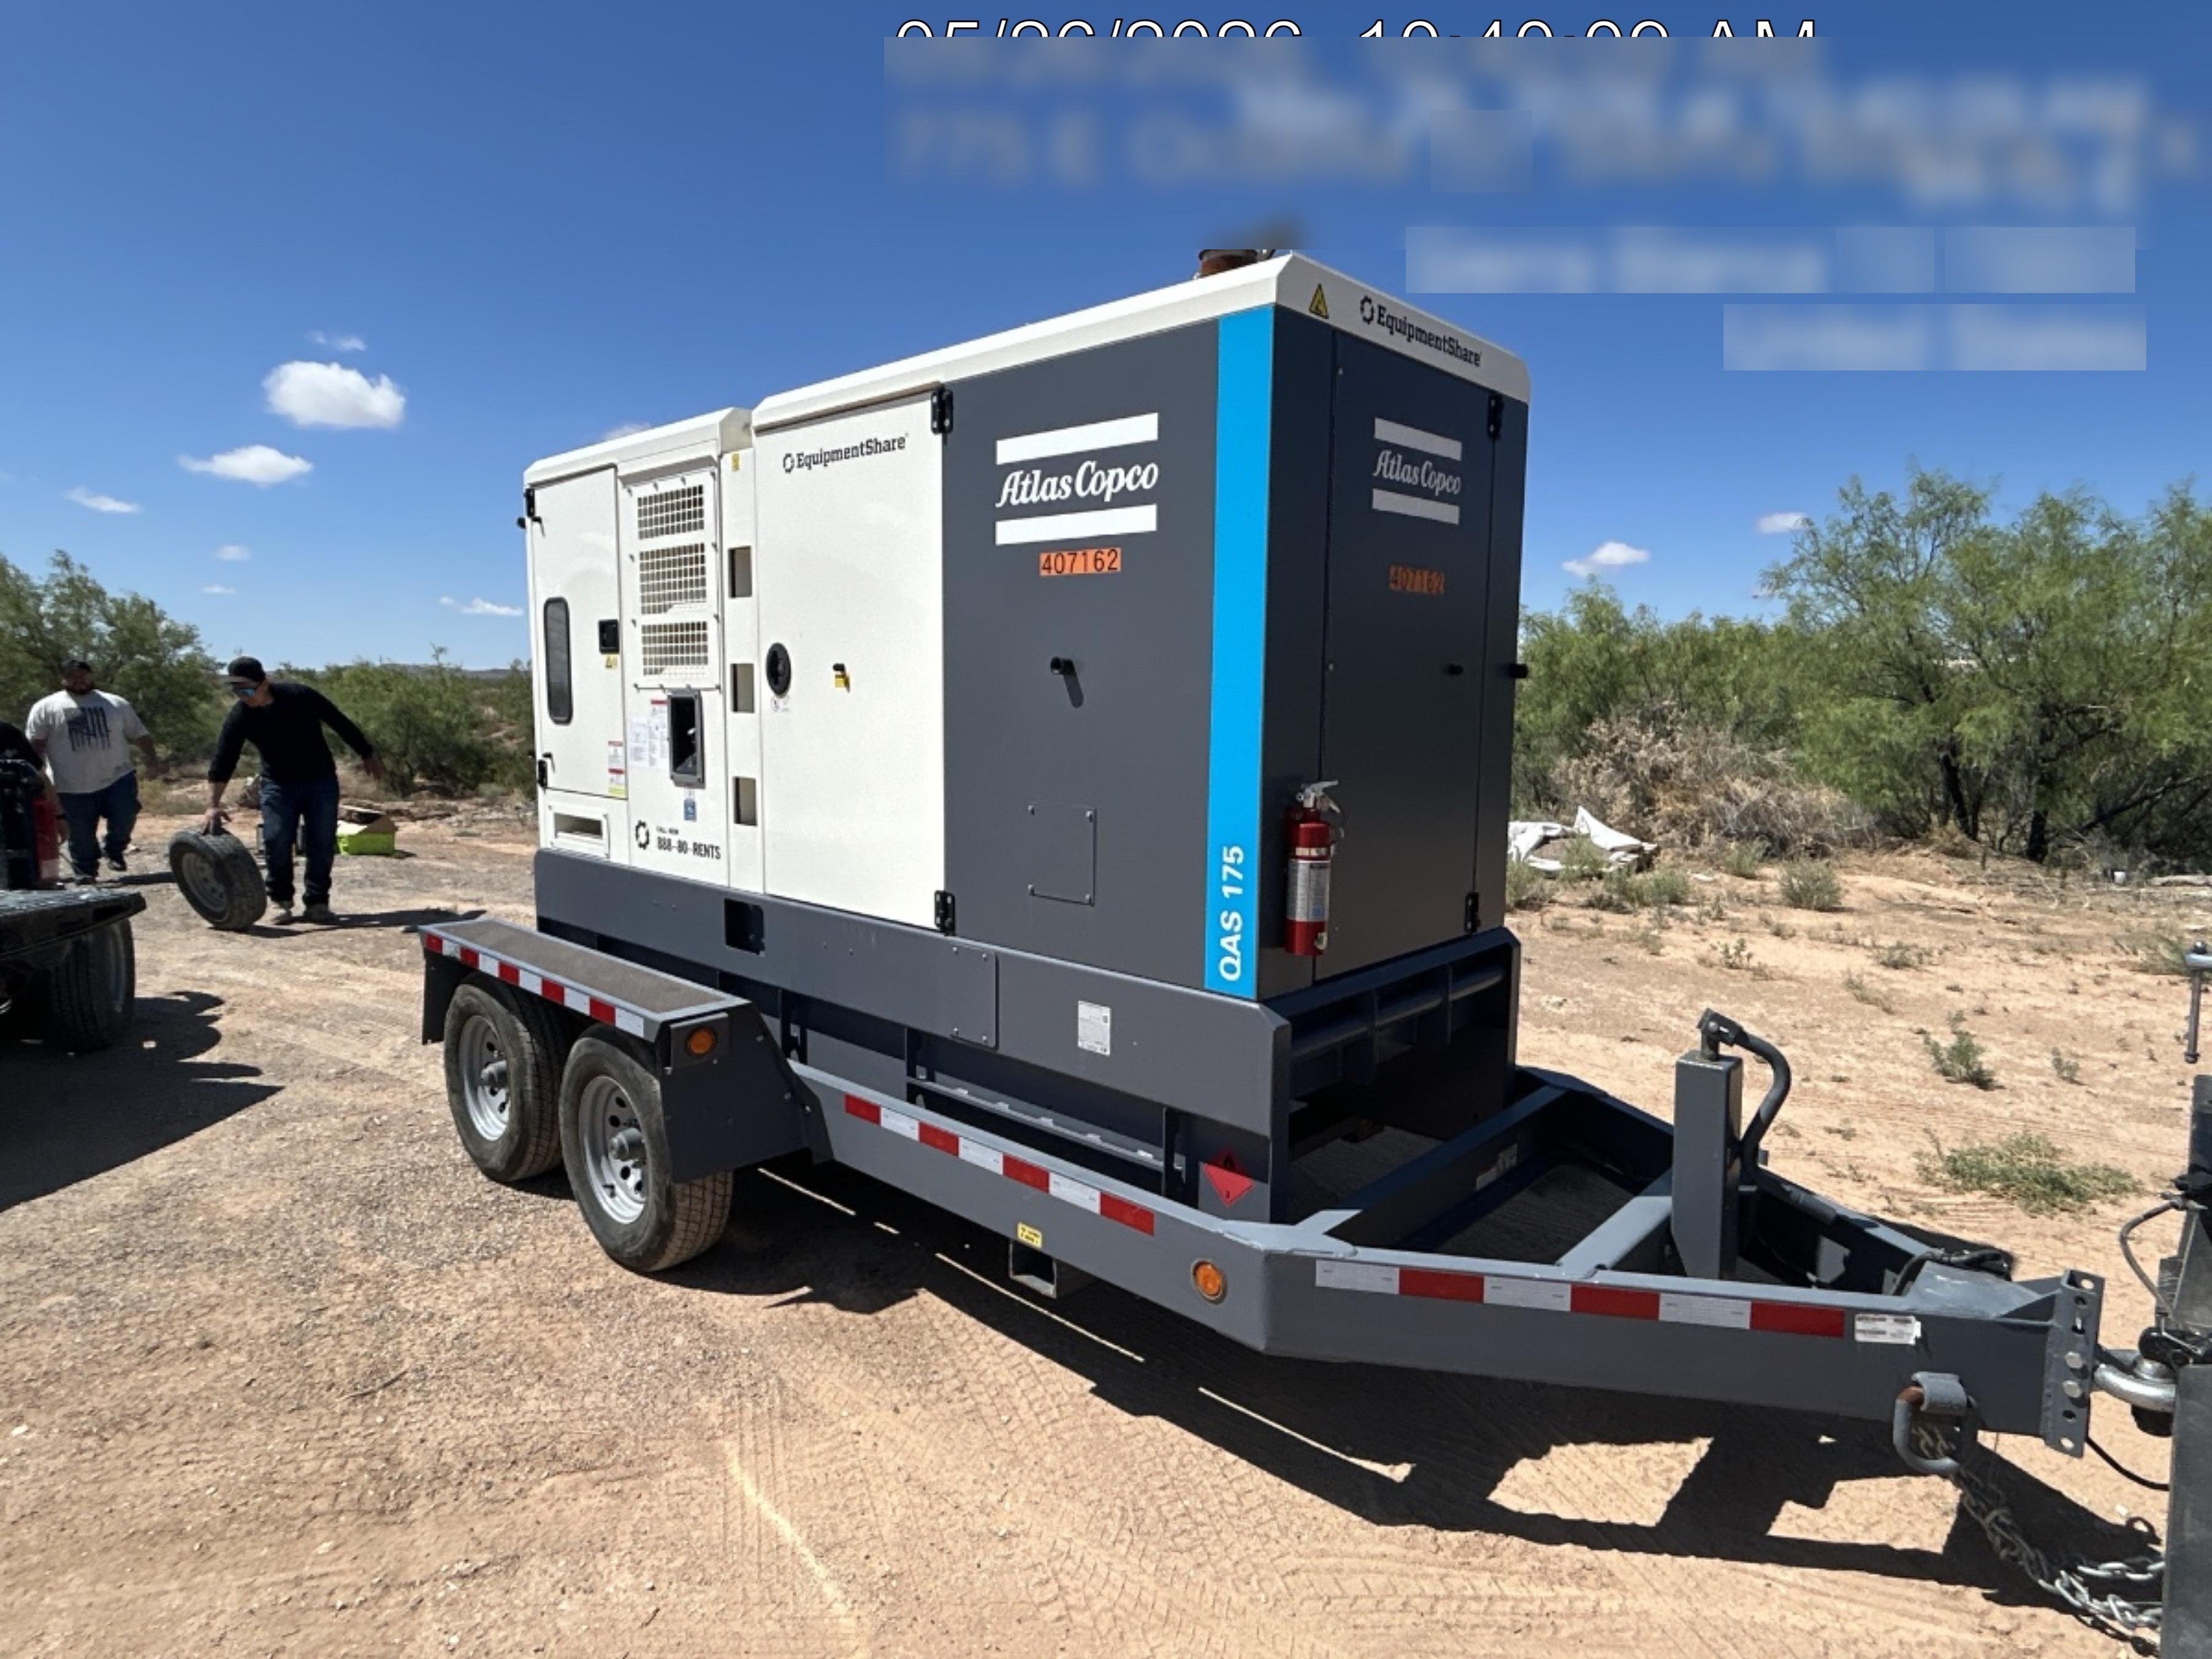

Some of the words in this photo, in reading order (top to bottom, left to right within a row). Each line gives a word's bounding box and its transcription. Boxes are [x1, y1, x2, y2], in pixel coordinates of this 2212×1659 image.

[1376, 304, 1481, 367] EquipmentShare
[796, 436, 906, 470] EquipmentShare
[1373, 449, 1420, 485] Atlas
[1420, 460, 1462, 496] Copco
[995, 469, 1073, 508] Atlas
[1075, 460, 1158, 502] Copco
[1041, 549, 1119, 574] 407162
[1222, 845, 1245, 899] 175
[1219, 910, 1243, 982] QAS
